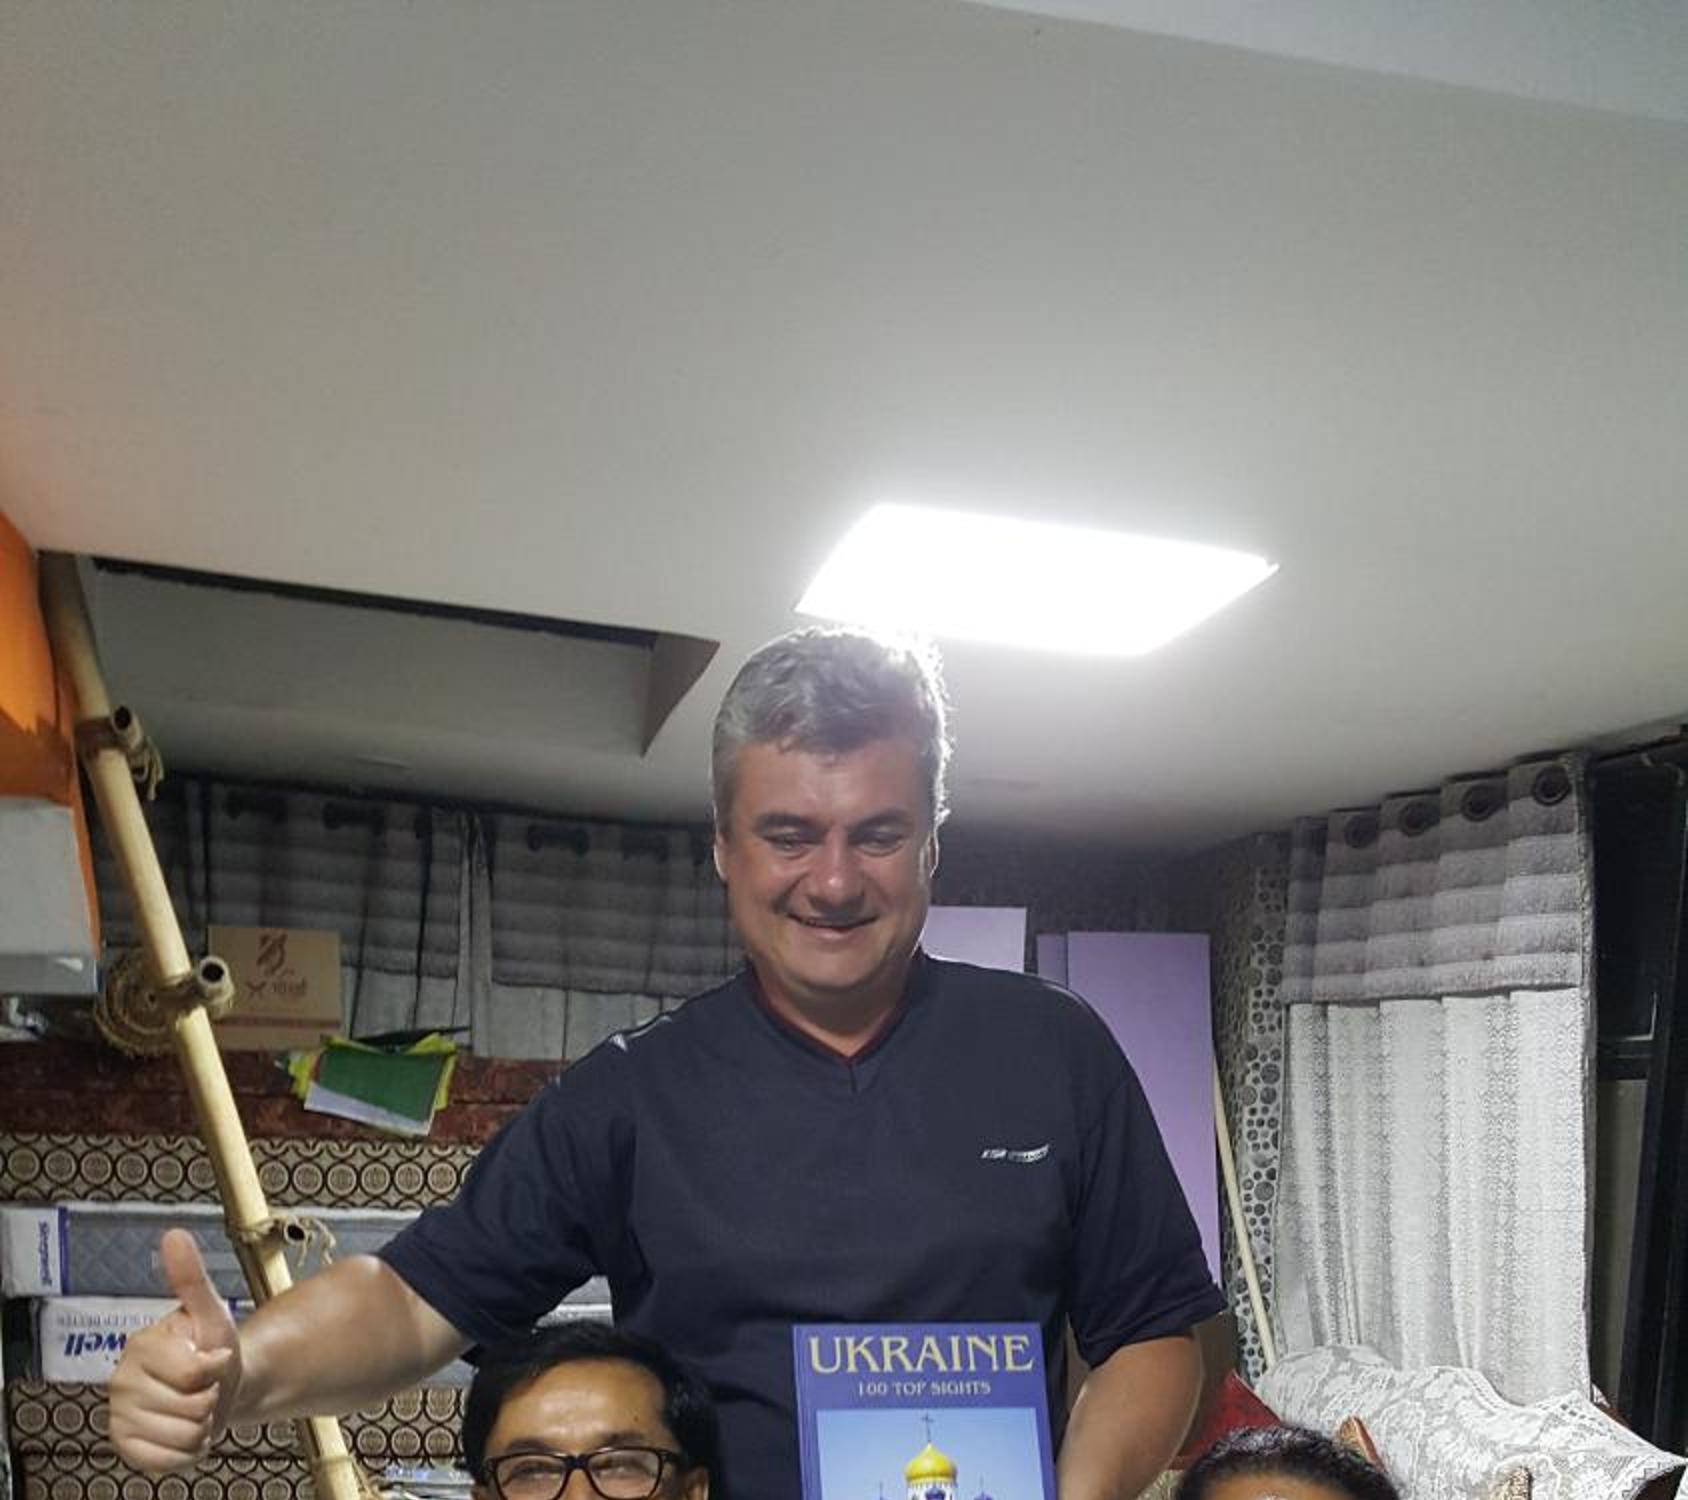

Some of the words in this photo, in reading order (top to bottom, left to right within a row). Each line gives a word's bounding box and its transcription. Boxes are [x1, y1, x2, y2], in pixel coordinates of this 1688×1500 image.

[809, 1334, 1034, 1374] UKRAINE
[859, 1381, 888, 1397] 100
[894, 1380, 926, 1397] TOP
[930, 1380, 992, 1397] SIGHTS
